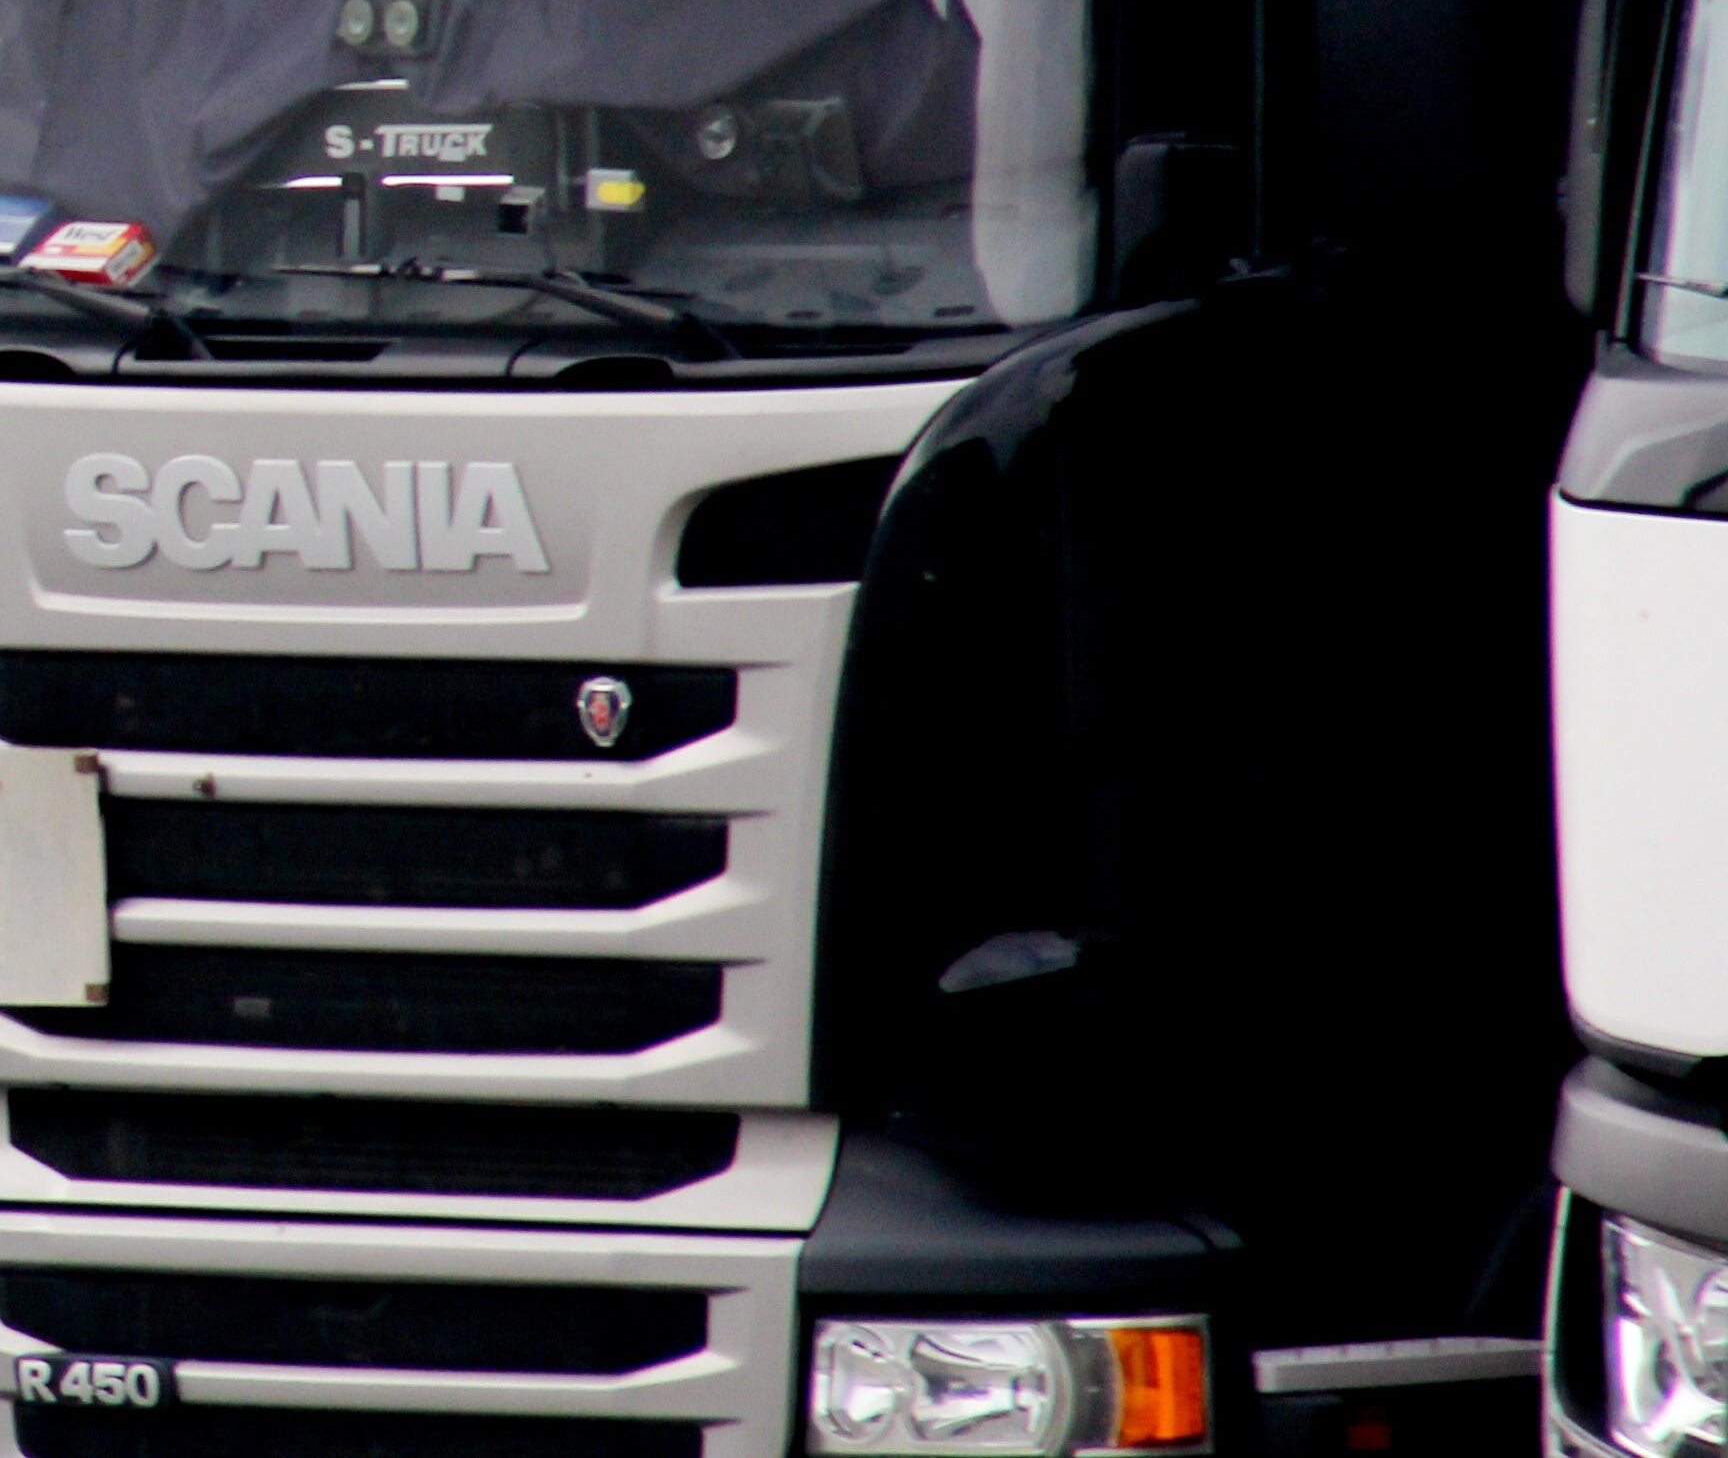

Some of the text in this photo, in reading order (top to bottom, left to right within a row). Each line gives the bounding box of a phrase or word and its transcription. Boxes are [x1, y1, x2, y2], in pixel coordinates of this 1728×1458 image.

[64, 451, 550, 573] SCANIA
[18, 1358, 161, 1408] R 450
